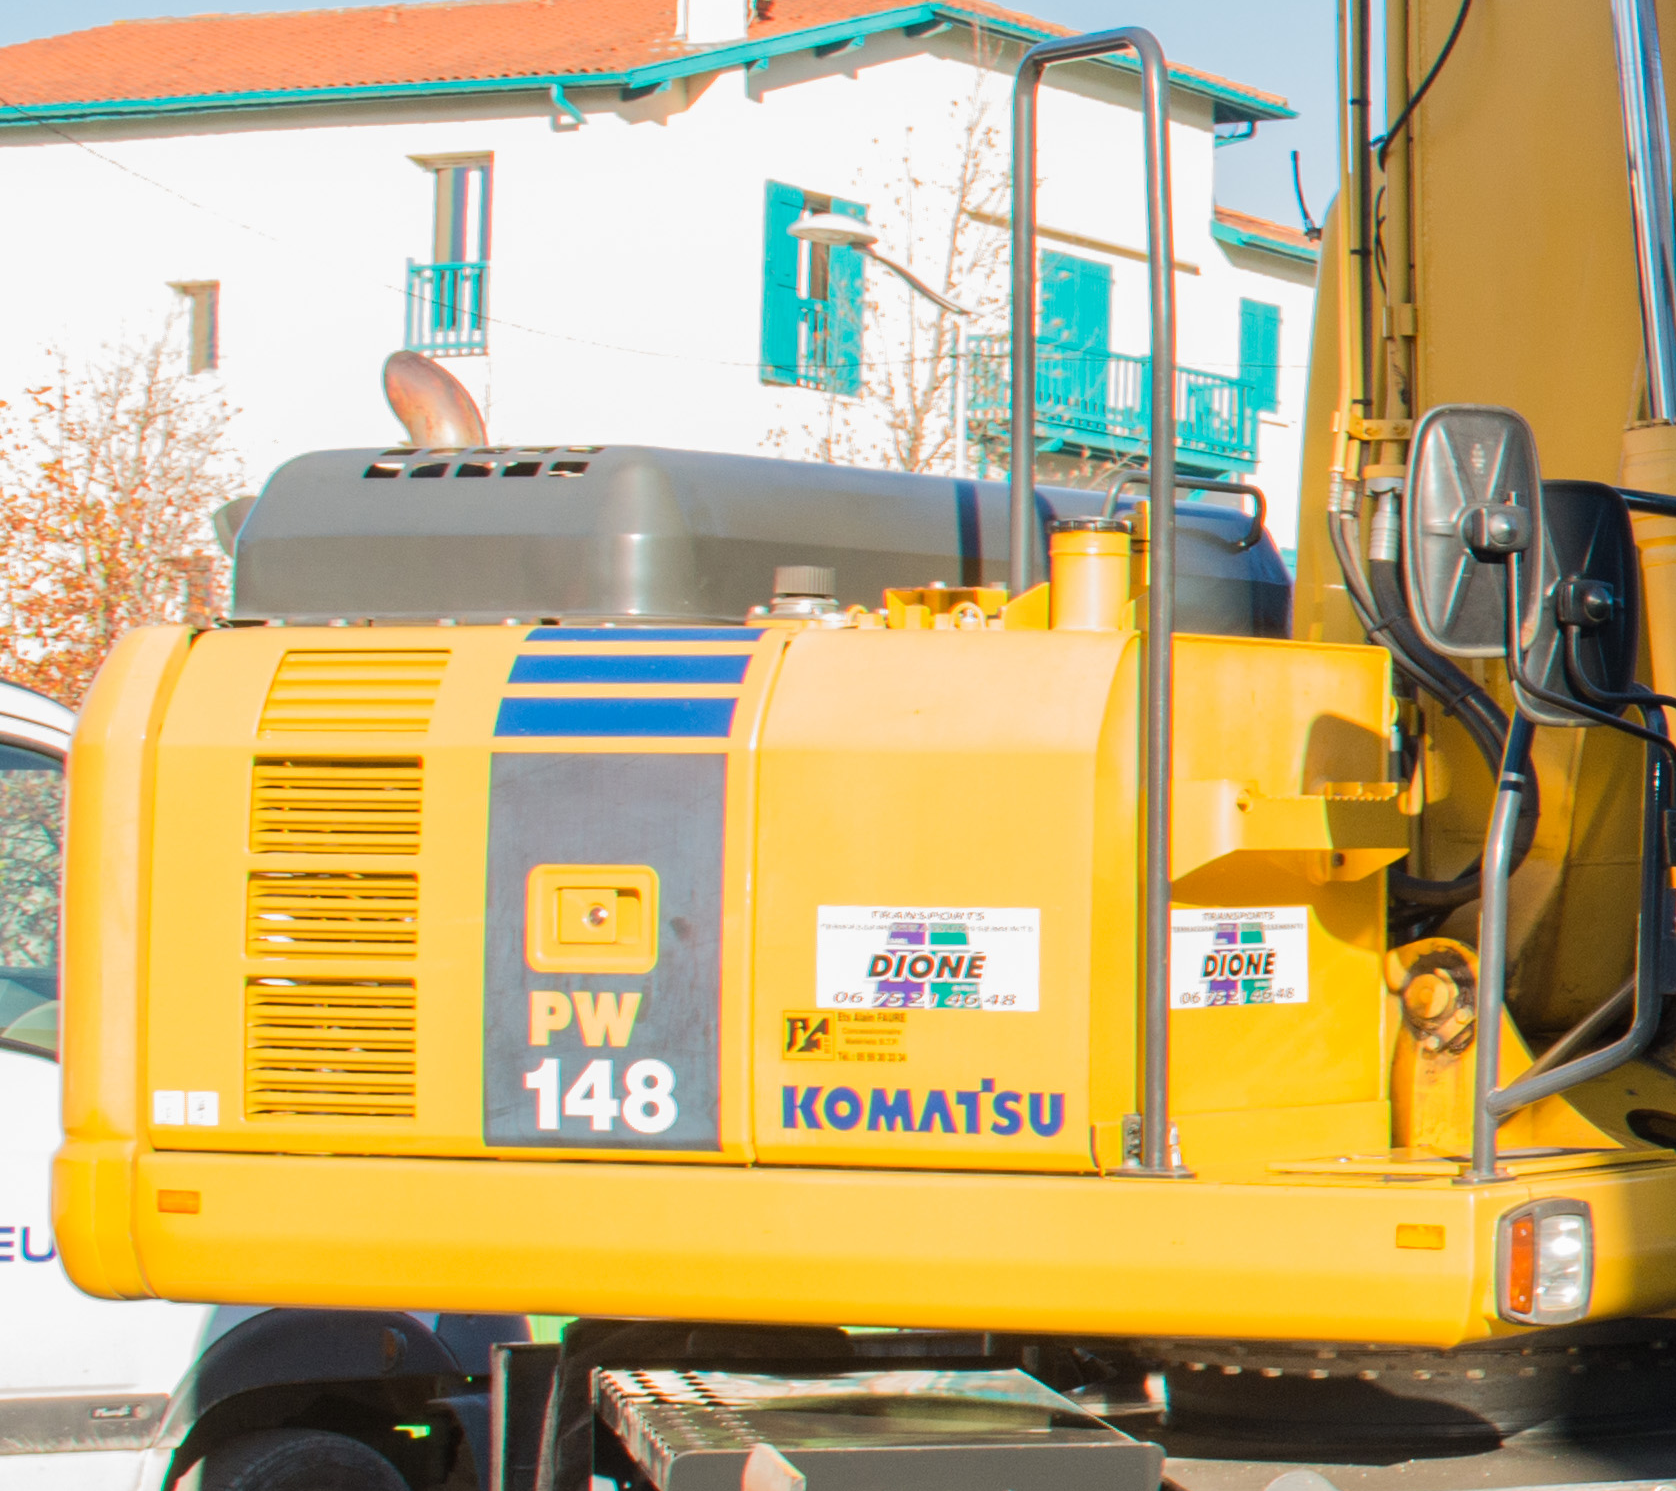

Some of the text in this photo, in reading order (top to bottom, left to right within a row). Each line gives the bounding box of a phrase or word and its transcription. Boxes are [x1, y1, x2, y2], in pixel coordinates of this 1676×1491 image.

[867, 951, 986, 979] DIONÉ
[1202, 949, 1276, 977] DIONÉ
[529, 991, 642, 1048] PW
[833, 991, 864, 1003] 06
[985, 993, 1017, 1006] 48
[523, 1058, 680, 1135] 148
[782, 1078, 1065, 1137] KOMATSU
